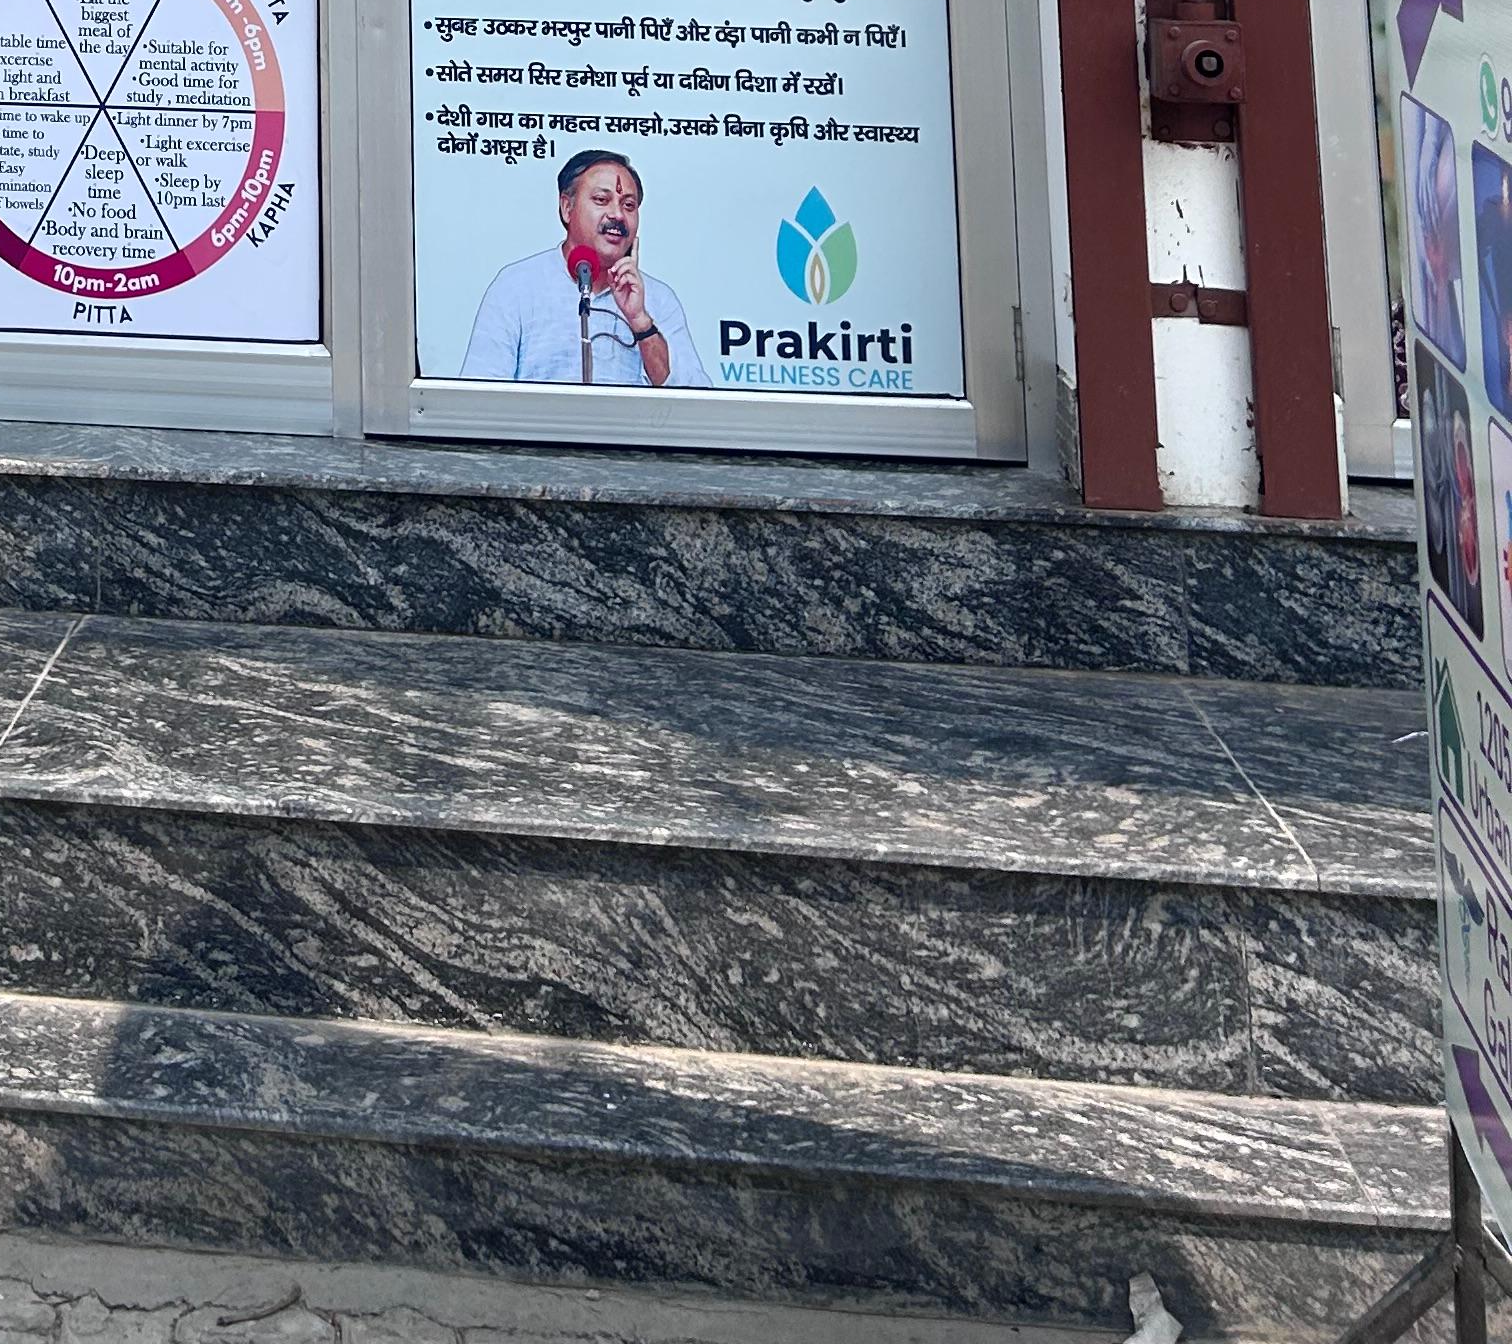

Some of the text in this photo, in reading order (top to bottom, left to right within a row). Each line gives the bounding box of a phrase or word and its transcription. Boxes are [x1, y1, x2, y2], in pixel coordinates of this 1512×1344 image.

[54, 264, 159, 292] 10pm-2am
[73, 302, 132, 324] PITTA
[720, 320, 912, 364] Prakirti
[721, 363, 912, 390] WELLNESS CARE
